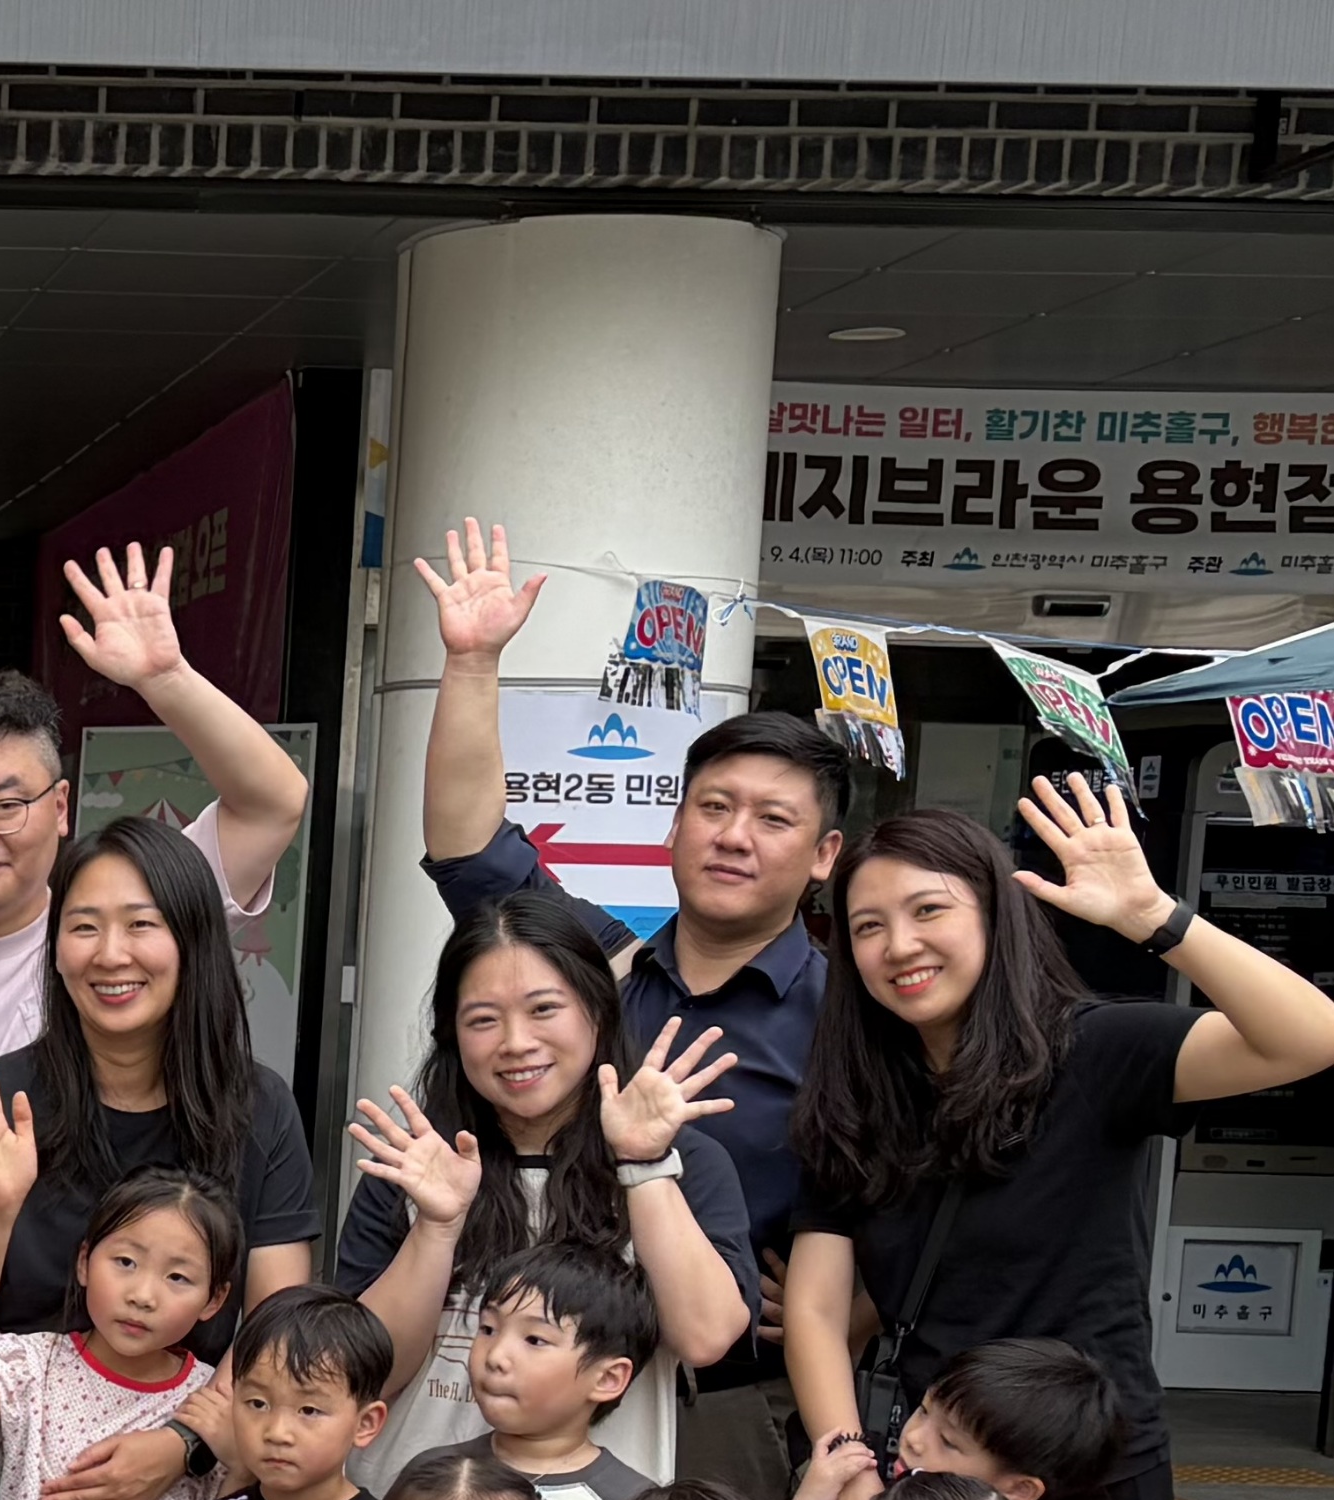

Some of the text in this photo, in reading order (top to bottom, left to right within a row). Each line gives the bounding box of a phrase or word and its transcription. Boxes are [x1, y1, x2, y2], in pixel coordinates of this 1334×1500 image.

[899, 407, 972, 442] 일터,
[985, 408, 1086, 442] 활기찬
[1097, 411, 1239, 446] 미추홀구,
[839, 548, 882, 566] 11:00
[901, 550, 934, 568] 주최
[991, 553, 1084, 571] 인천광역시
[1091, 555, 1168, 575] 미추홀구
[1187, 556, 1222, 574] 주관
[635, 604, 704, 657] OPEN
[821, 654, 888, 709] OPEN
[1024, 682, 1112, 747] OPEN
[505, 772, 683, 806] 용현2동 민원
